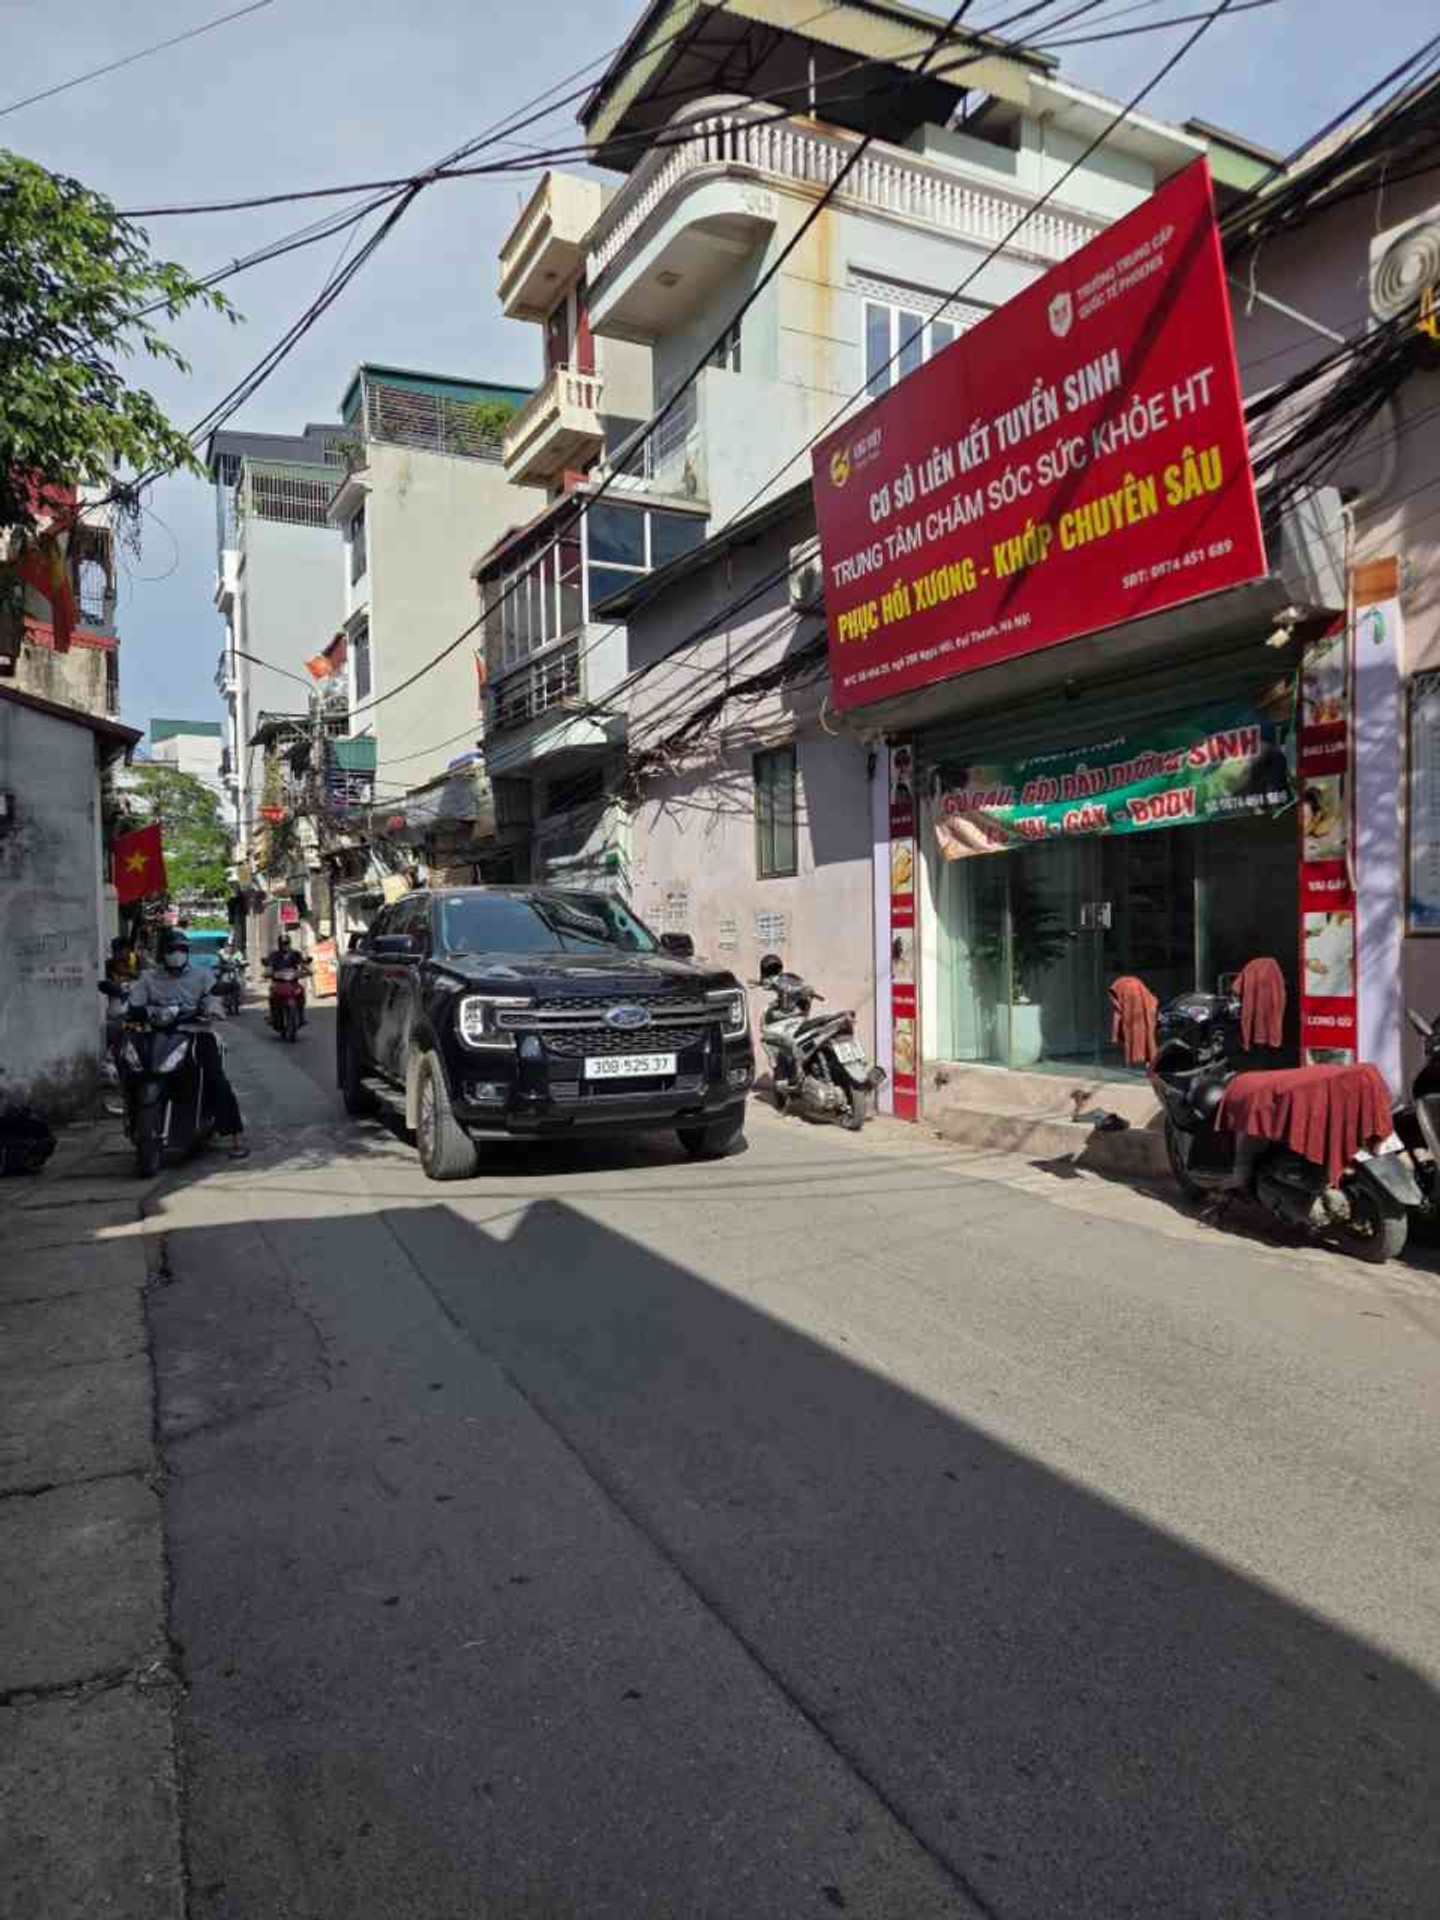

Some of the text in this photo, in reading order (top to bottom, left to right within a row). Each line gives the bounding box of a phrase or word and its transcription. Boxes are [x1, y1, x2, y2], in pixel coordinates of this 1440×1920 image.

[832, 366, 1214, 589] TRUNG TÂM CHĂM SÓC SỨC KHỎE HT
[869, 348, 1122, 523] CƠ SỞ LIÊN KẾT TUYỂN SINH
[837, 600, 879, 643] PHỤC
[881, 578, 912, 625] HỒI
[912, 557, 977, 612] XƯƠNG
[993, 519, 1053, 578] KHỚP
[1059, 472, 1159, 551] CHUYÊN
[1164, 444, 1223, 506] SÂU
[1127, 786, 1196, 825] BODY
[1187, 725, 1262, 768] SINH
